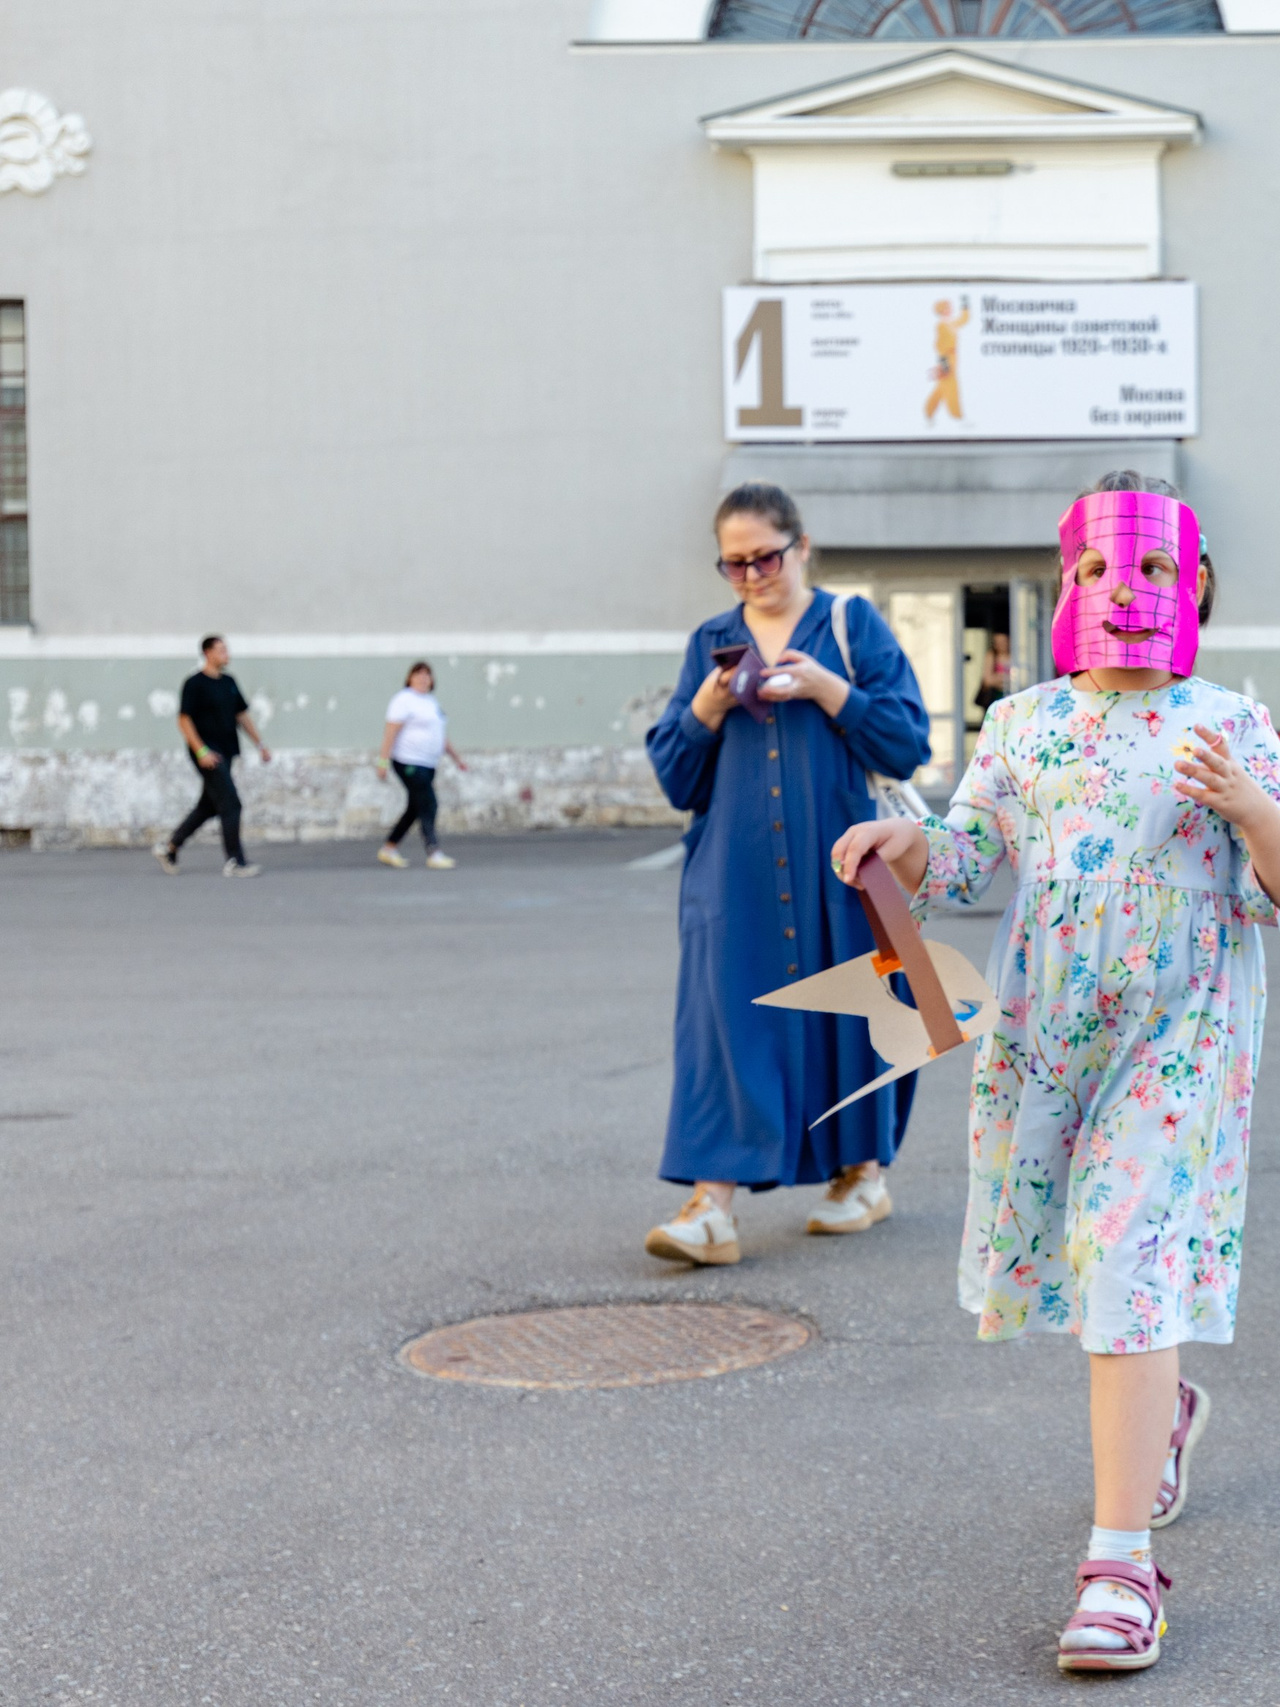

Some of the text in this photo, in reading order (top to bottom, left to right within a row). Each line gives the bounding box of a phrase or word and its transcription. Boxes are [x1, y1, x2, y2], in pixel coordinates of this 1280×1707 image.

[981, 296, 1077, 314] Москвичка
[981, 315, 1160, 336] Женщины советской
[981, 342, 1056, 358] столицы
[735, 298, 804, 428] 1
[1119, 385, 1185, 403] Москва
[1089, 406, 1186, 427] без окраин
